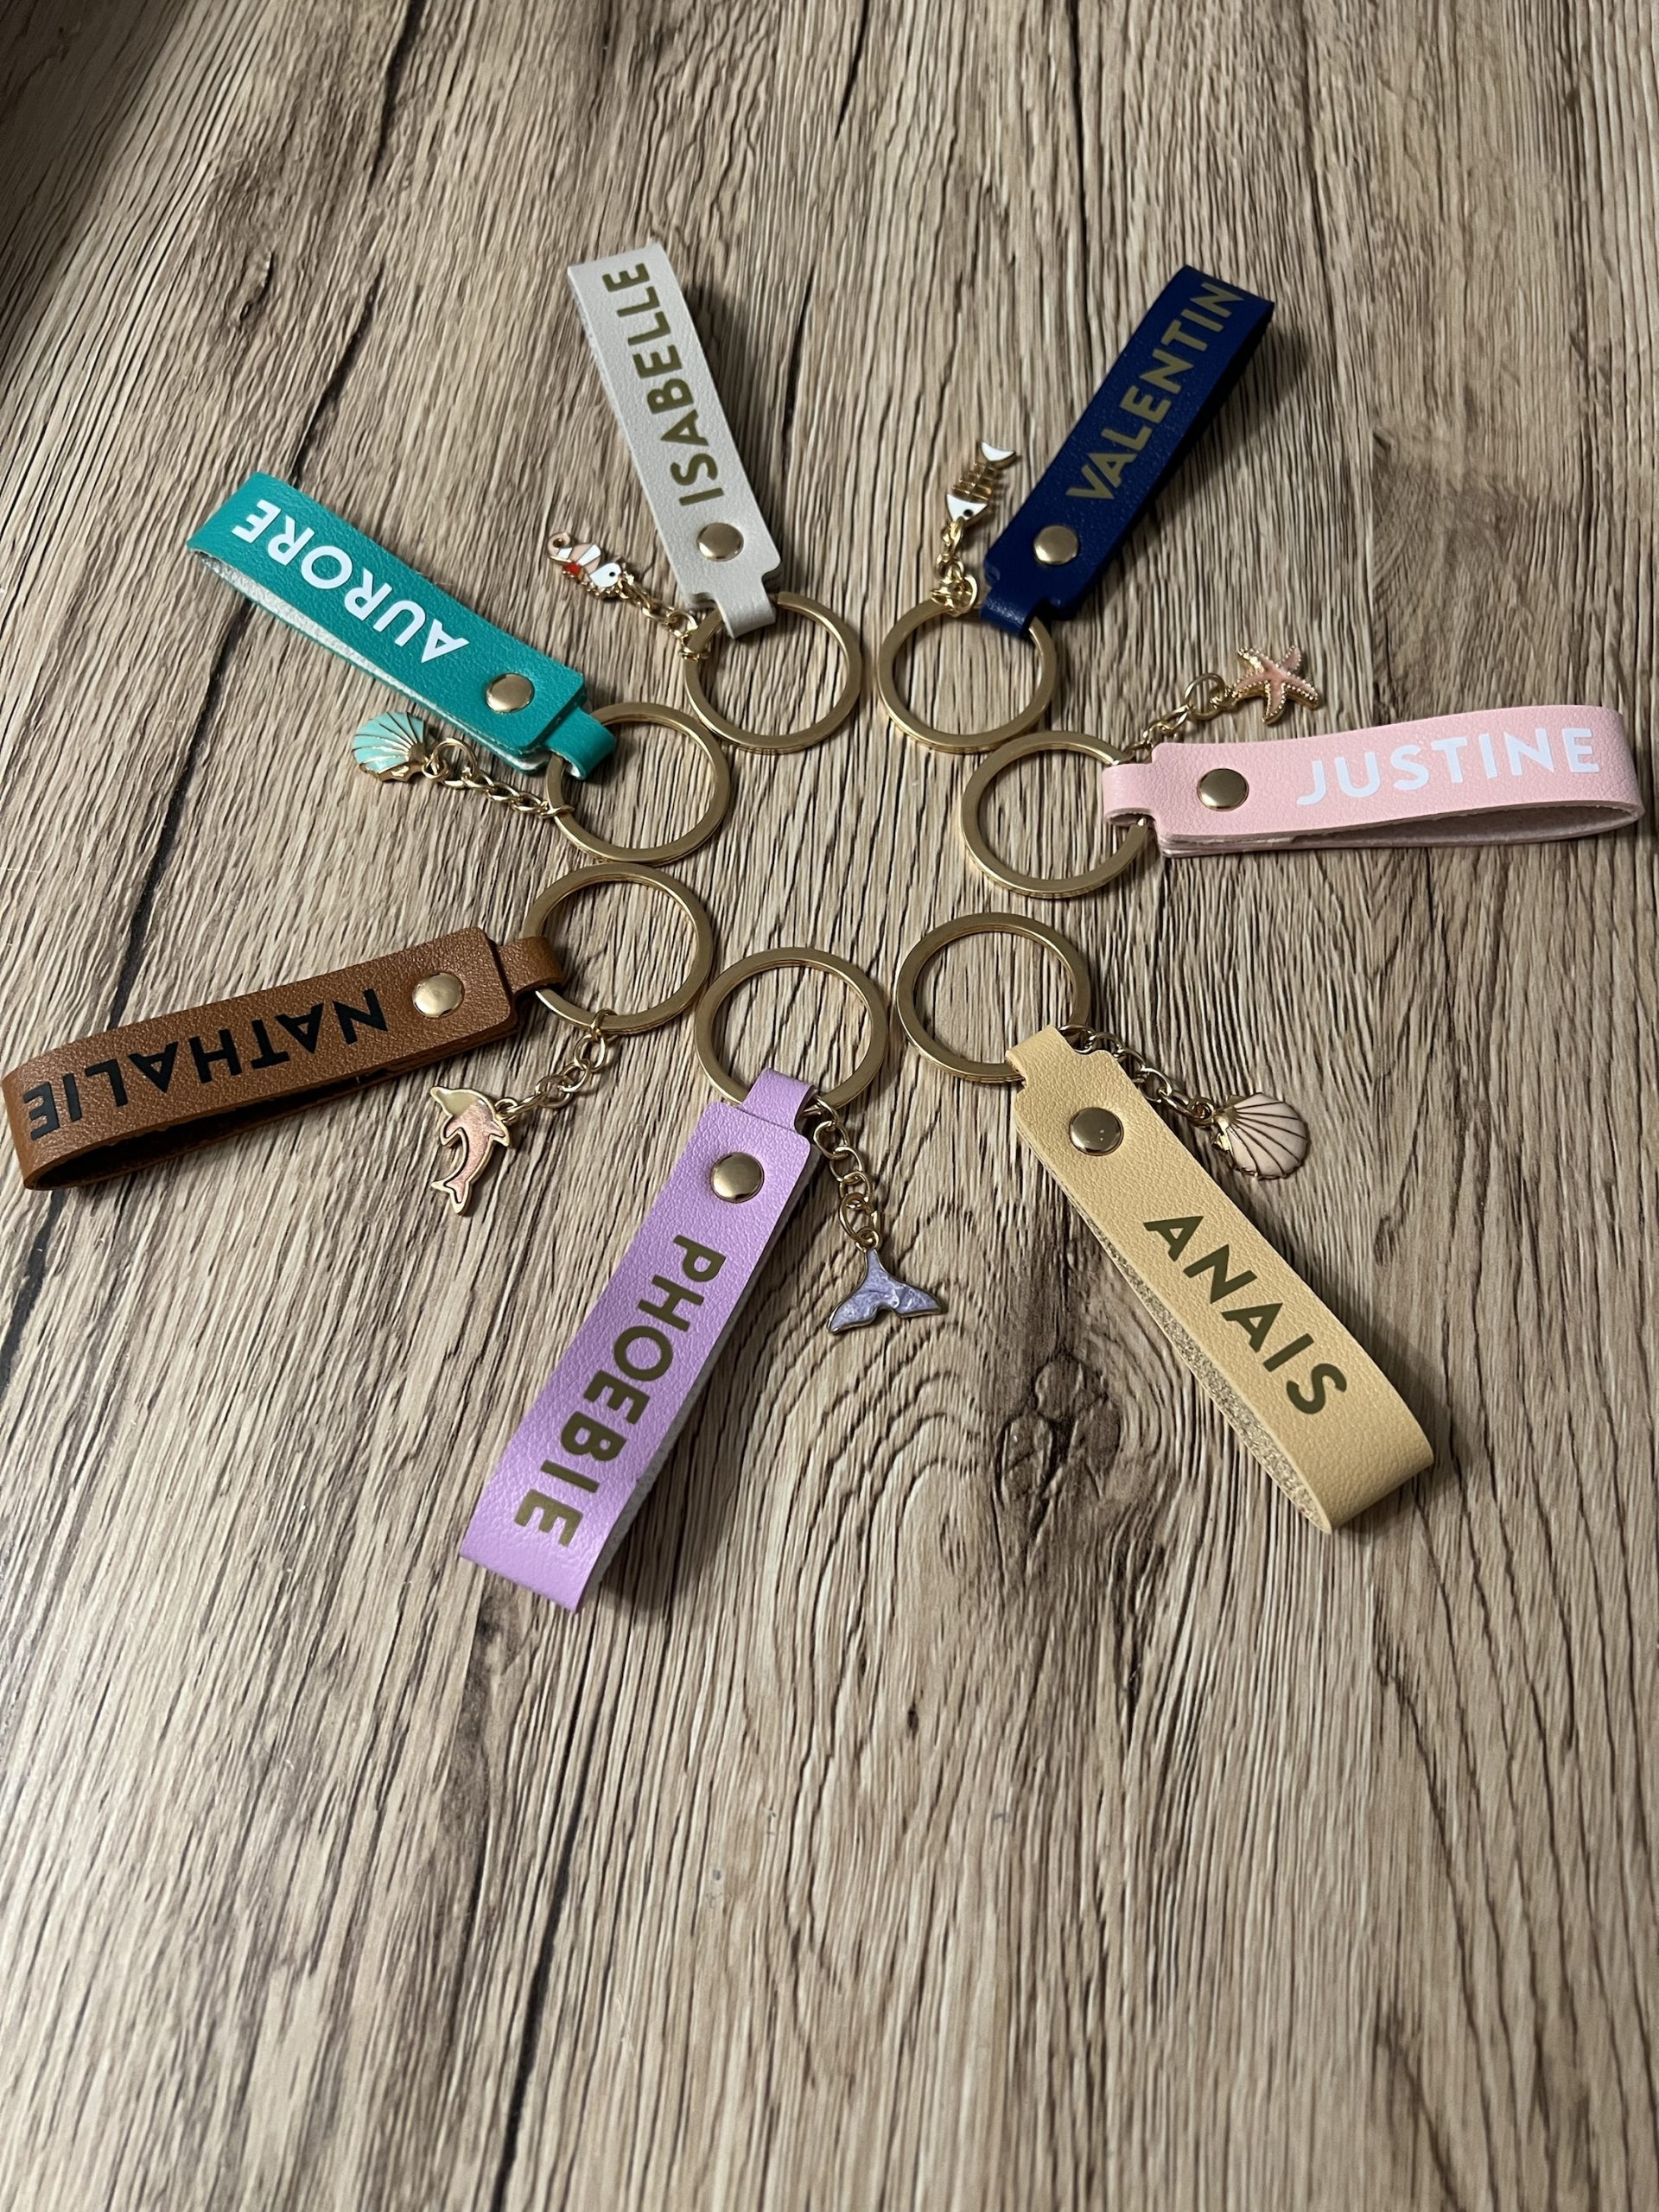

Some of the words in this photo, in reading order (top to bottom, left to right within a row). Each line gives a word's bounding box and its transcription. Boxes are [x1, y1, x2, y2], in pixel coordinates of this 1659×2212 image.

[602, 263, 724, 506] ISABELLE
[1065, 282, 1244, 499] VALENTIN
[231, 499, 470, 664] AURORE
[1296, 728, 1599, 805] JUSTINE
[22, 988, 389, 1141] NATHALIE
[513, 1234, 727, 1548] PHOEBIE
[1143, 1216, 1347, 1414] ANAIS
